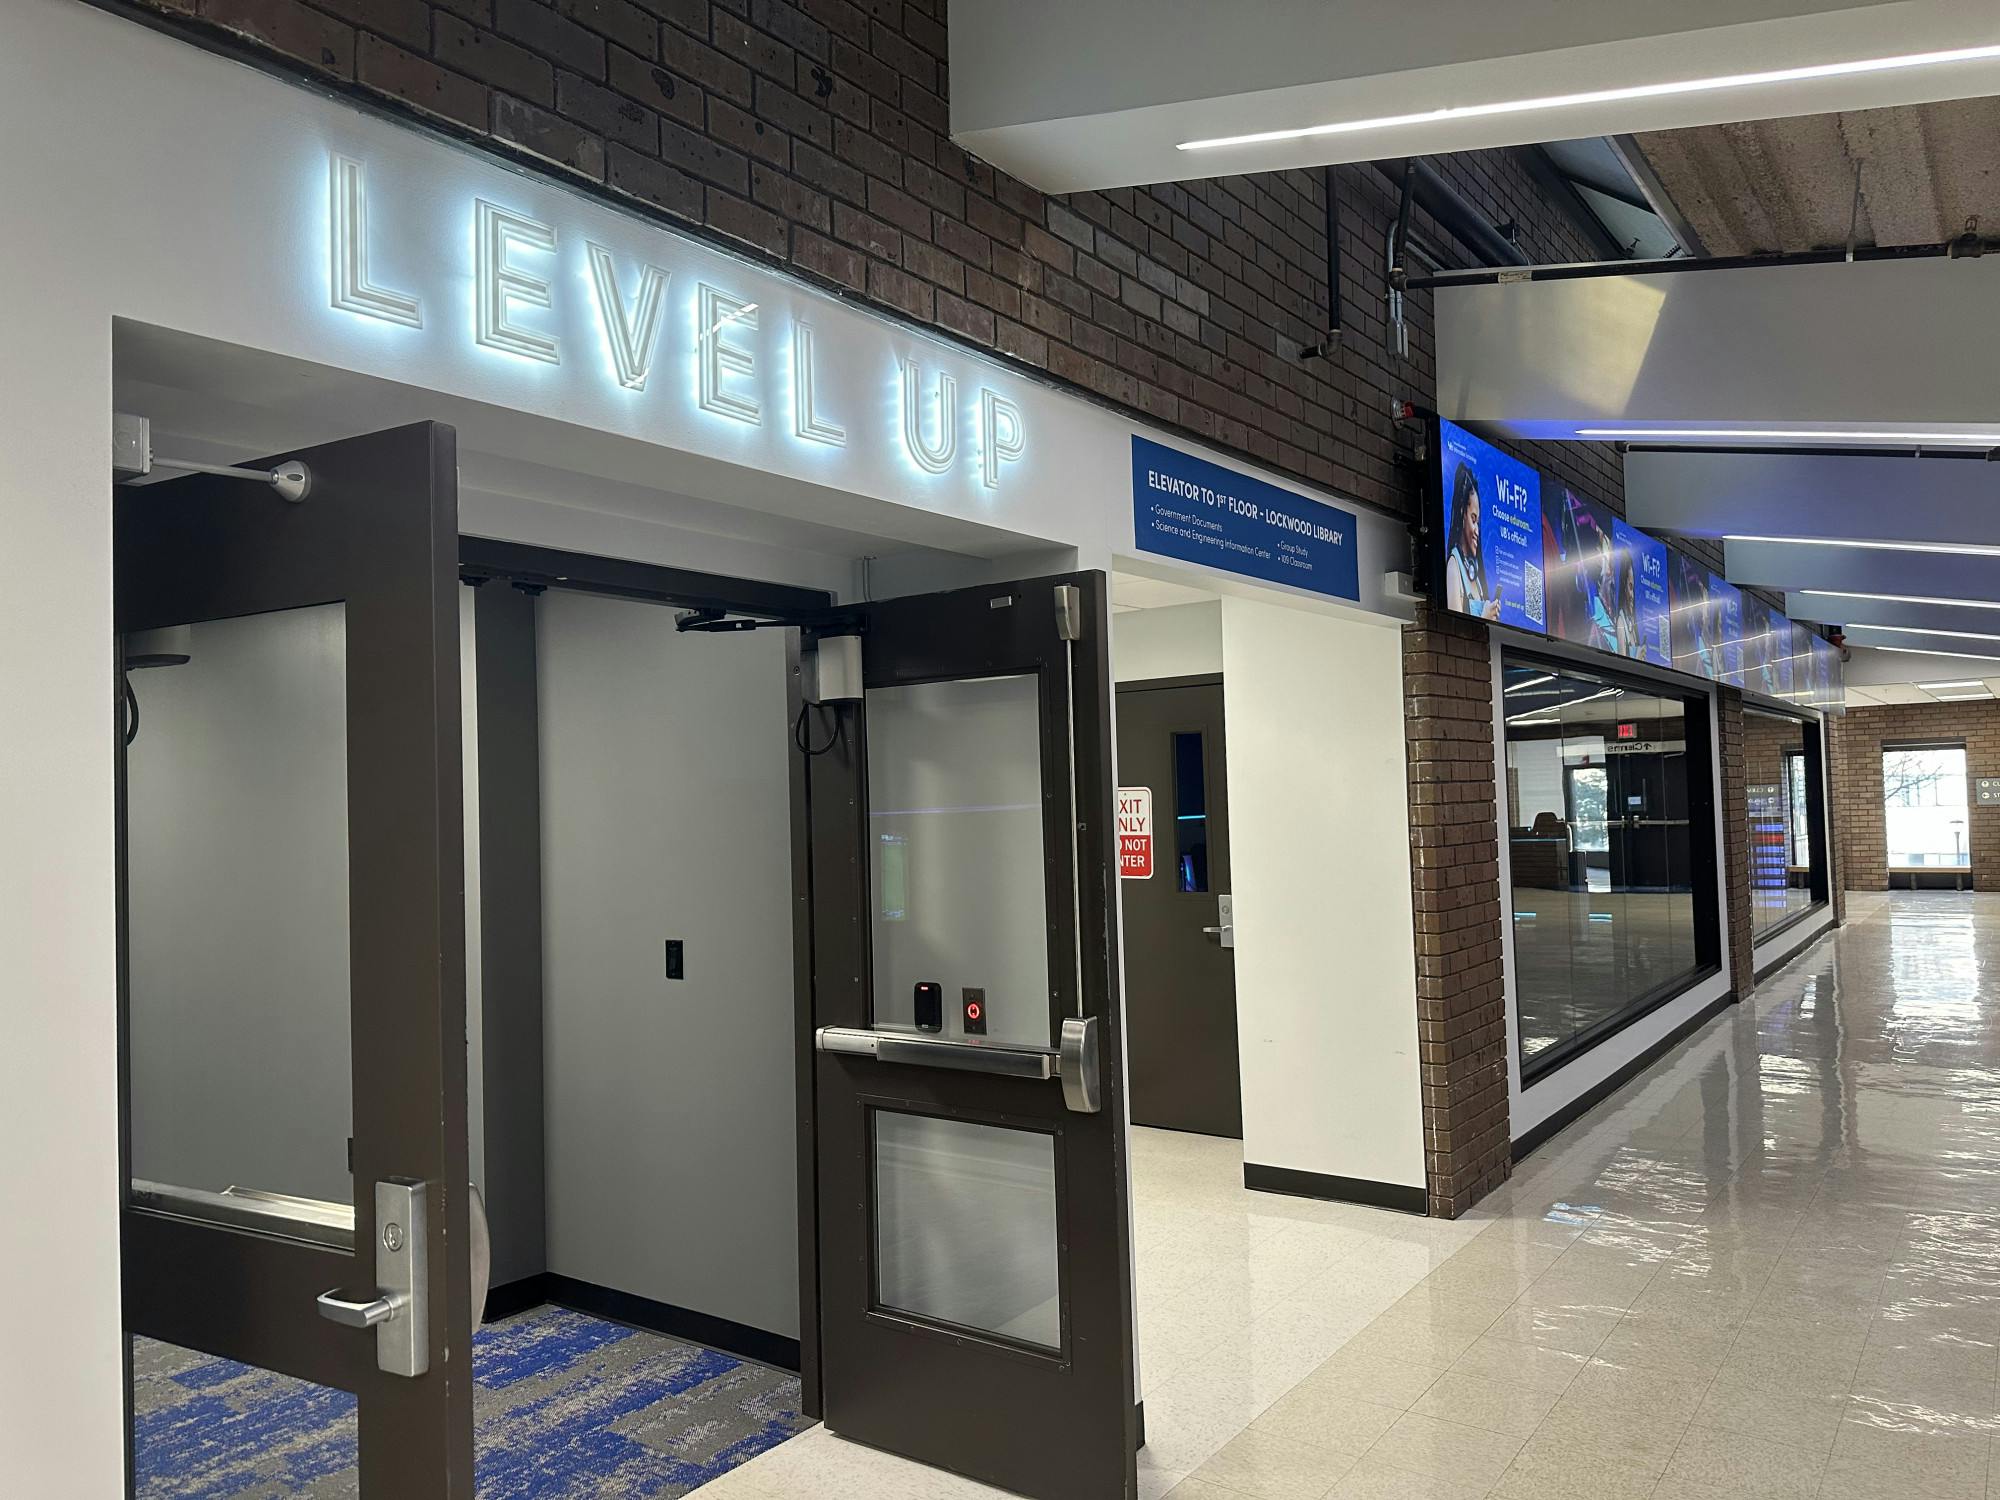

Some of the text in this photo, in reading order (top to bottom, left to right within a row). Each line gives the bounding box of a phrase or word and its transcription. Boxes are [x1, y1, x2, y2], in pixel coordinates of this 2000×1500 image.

[330, 151, 1028, 490] LEVEL UP
[1495, 474, 1528, 513] Wi-Fi?
[1148, 470, 1200, 502] ELEVATOR
[1201, 487, 1215, 506] TO
[1216, 493, 1227, 508] 1ST
[1228, 496, 1258, 520] FLOOR
[1265, 508, 1312, 536] LOCKWOOD
[1313, 524, 1343, 547] LIBRARY
[1154, 503, 1223, 532] Government Documents
[1492, 504, 1510, 523] Choose
[1155, 519, 1271, 559] Science and Engineering Information Center
[1280, 540, 1309, 558] Group Study
[1641, 552, 1661, 578] Wi-Fi?
[1119, 799, 1142, 814] XIT
[1118, 817, 1146, 832] NLY
[1125, 838, 1147, 851] NOT
[1119, 855, 1145, 867] NTER
